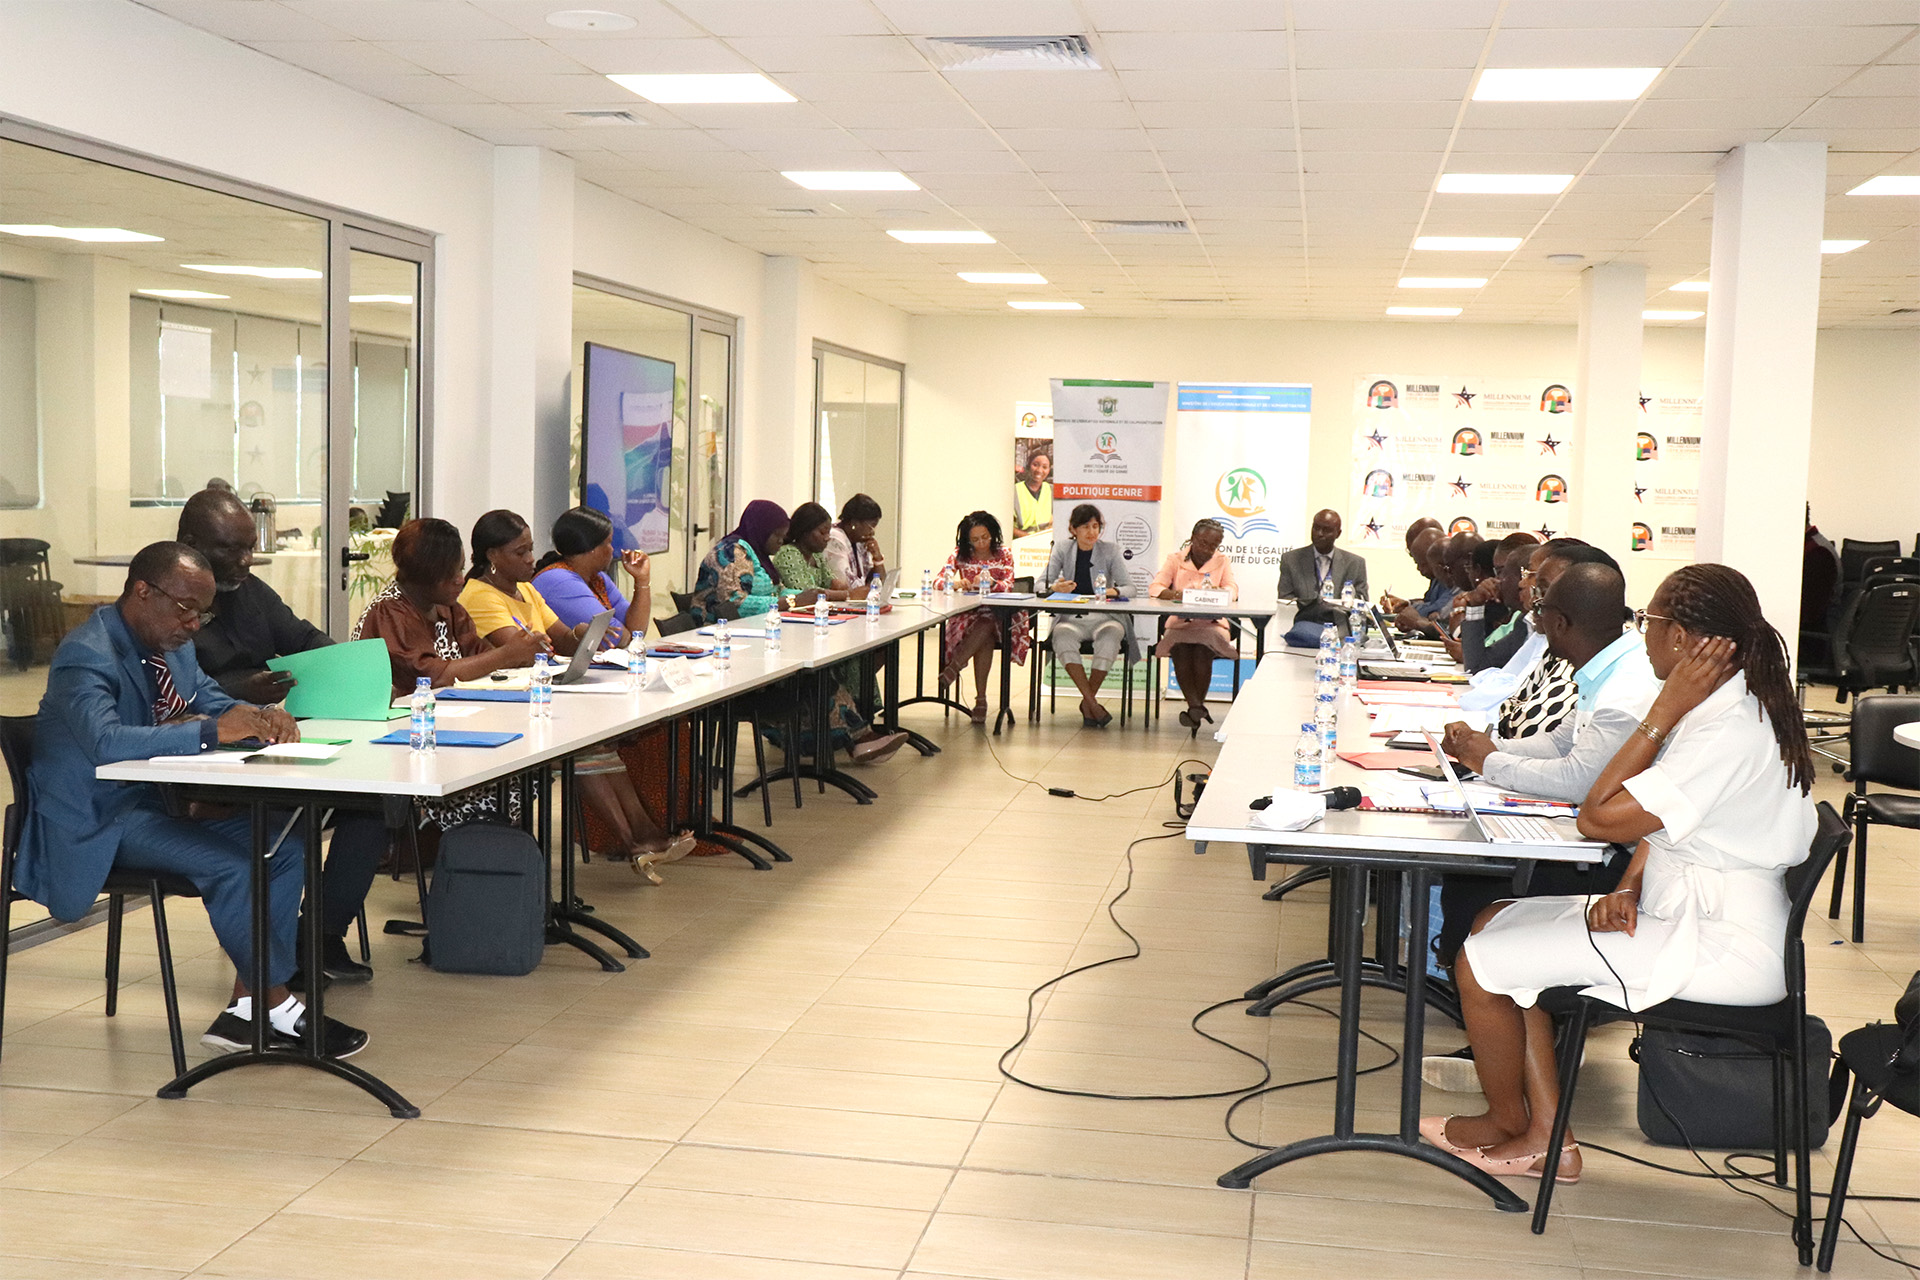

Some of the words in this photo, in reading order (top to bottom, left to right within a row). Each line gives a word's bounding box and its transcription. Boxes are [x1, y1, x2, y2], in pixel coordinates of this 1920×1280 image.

[1405, 384, 1440, 393] MILLENNIUM
[1490, 431, 1525, 440] MILLENNIUM
[1666, 436, 1702, 445] MILLENNIUM
[1062, 486, 1110, 497] POLITIQUE
[1111, 487, 1143, 497] GENRE
[1486, 520, 1521, 530] MILLENNIUM
[1661, 526, 1697, 536] MILLENNIUM
[1235, 545, 1247, 554] DE
[1248, 556, 1261, 565] DU
[1262, 556, 1281, 565] GEN
[1194, 596, 1219, 604] CABINET
